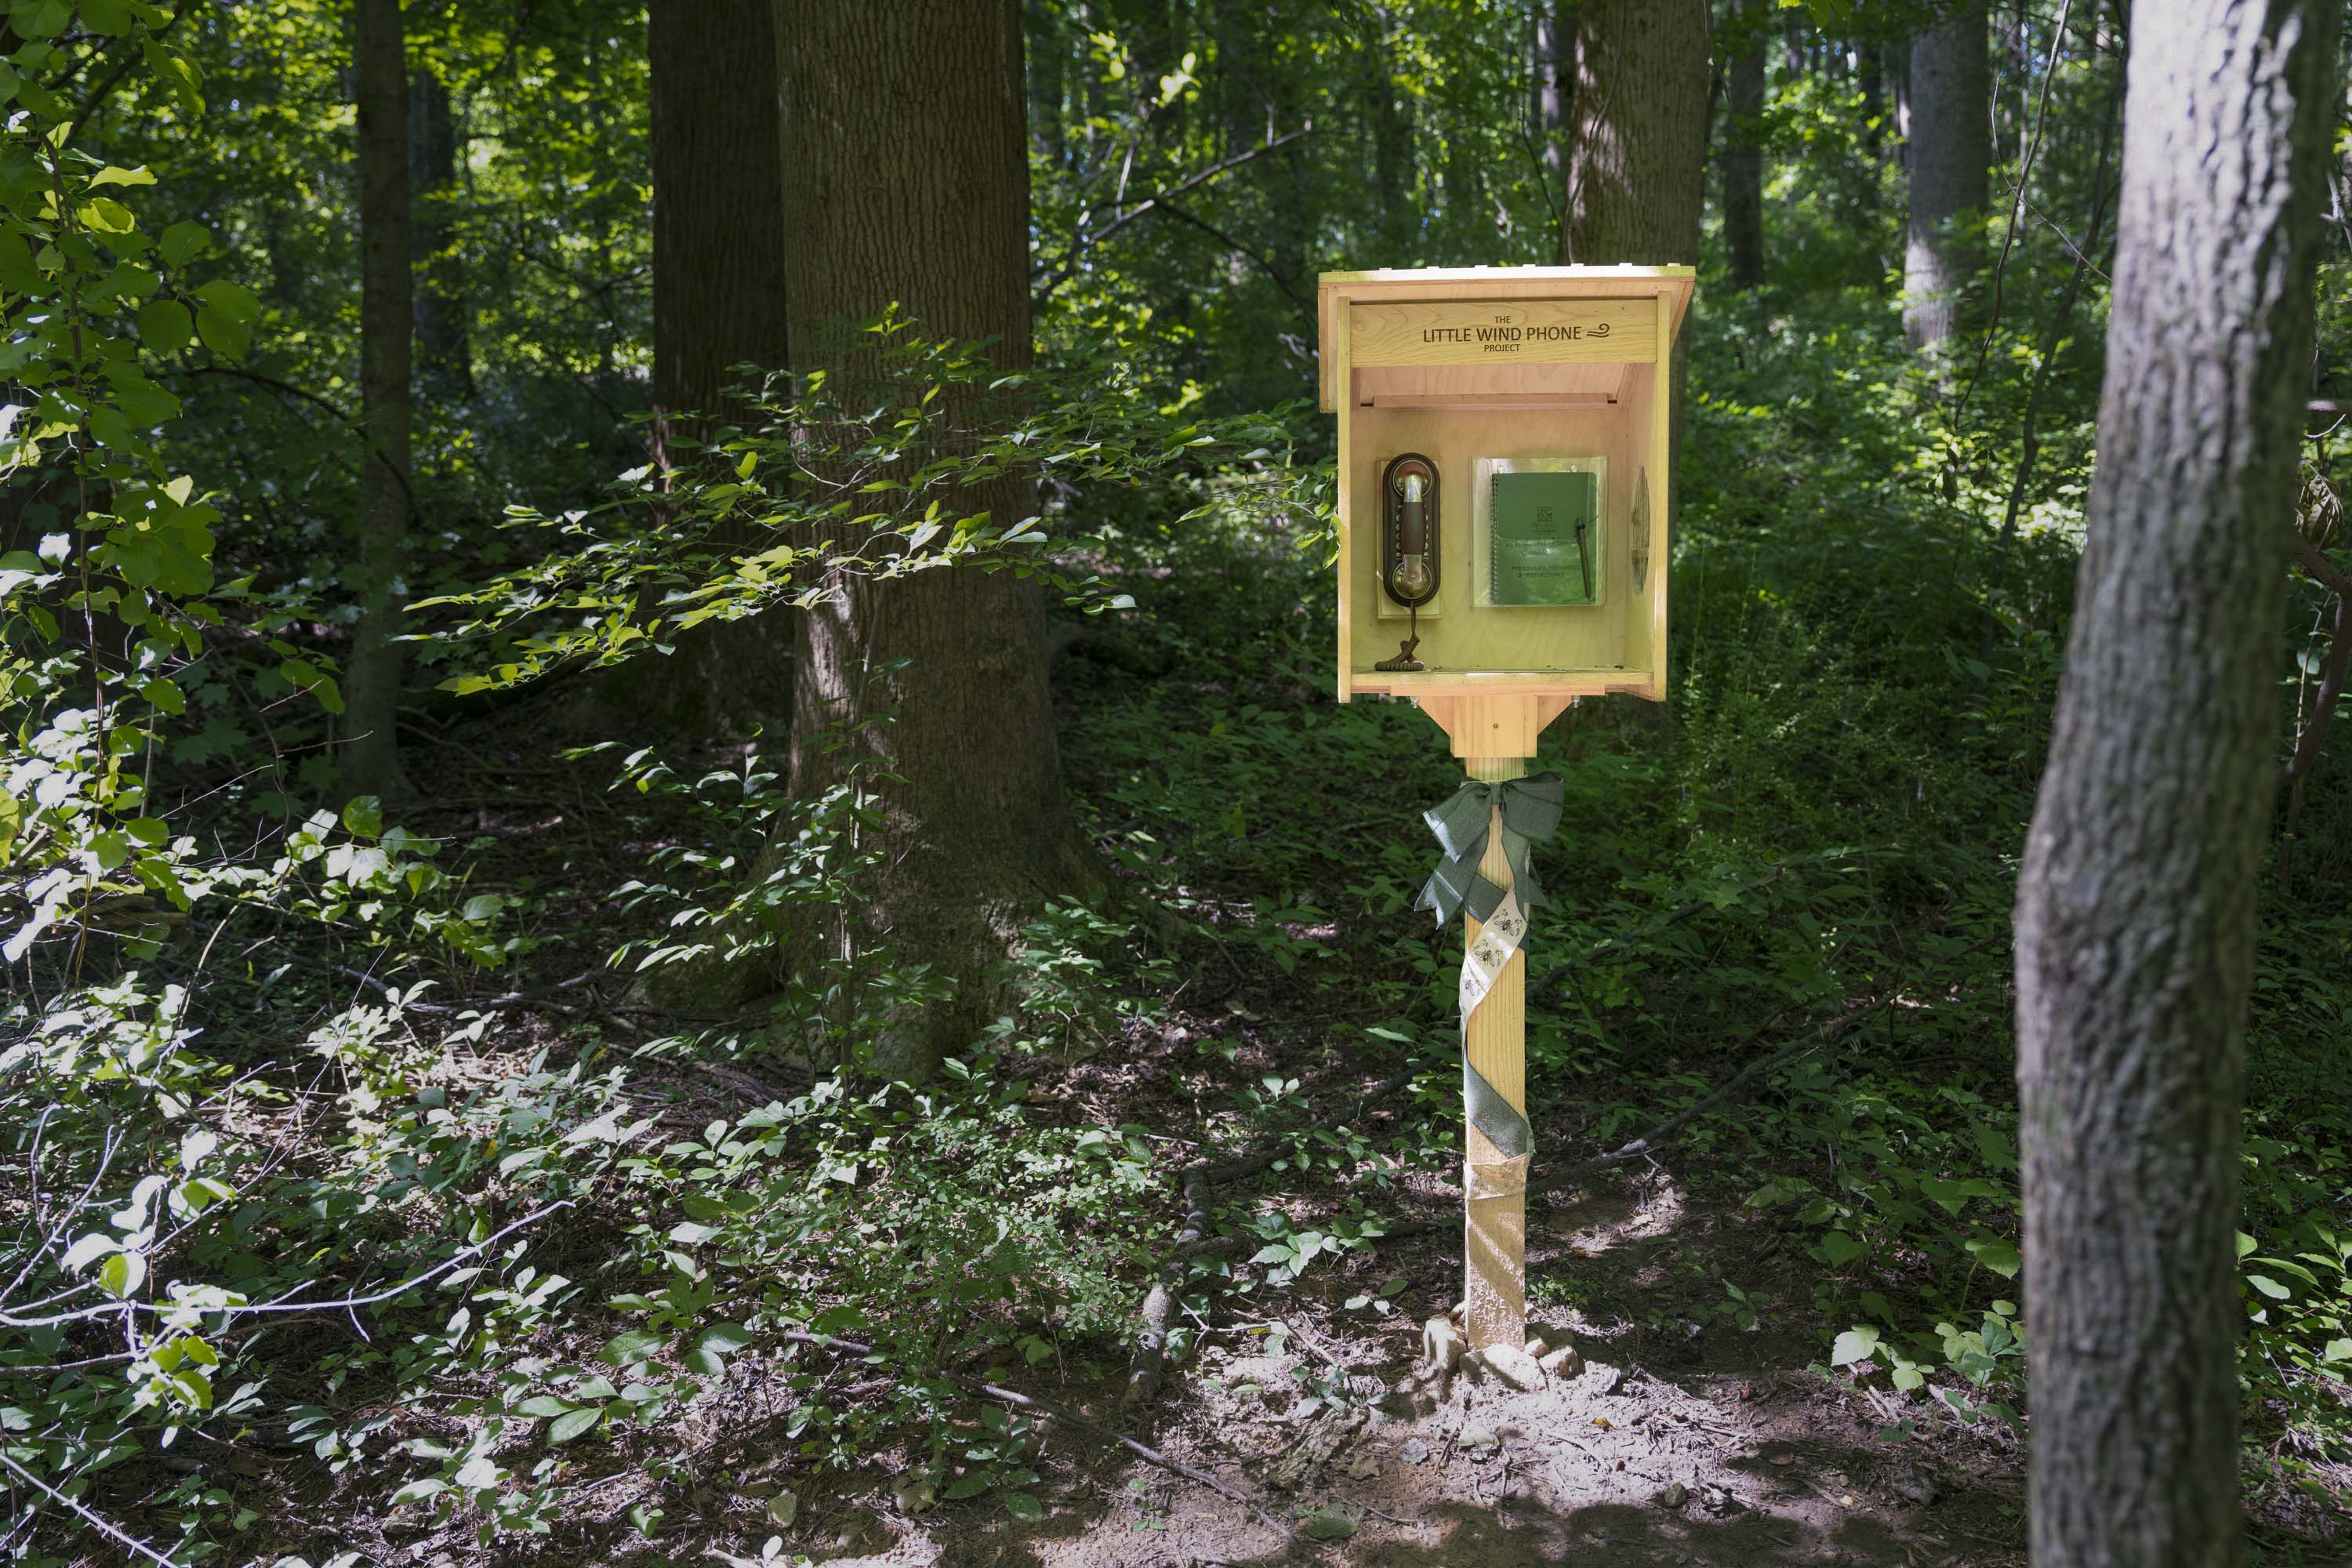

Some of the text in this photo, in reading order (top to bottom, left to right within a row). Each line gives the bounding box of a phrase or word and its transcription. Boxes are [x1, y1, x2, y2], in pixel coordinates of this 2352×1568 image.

[1424, 326, 1581, 342] LITTLE WIND PHONE
